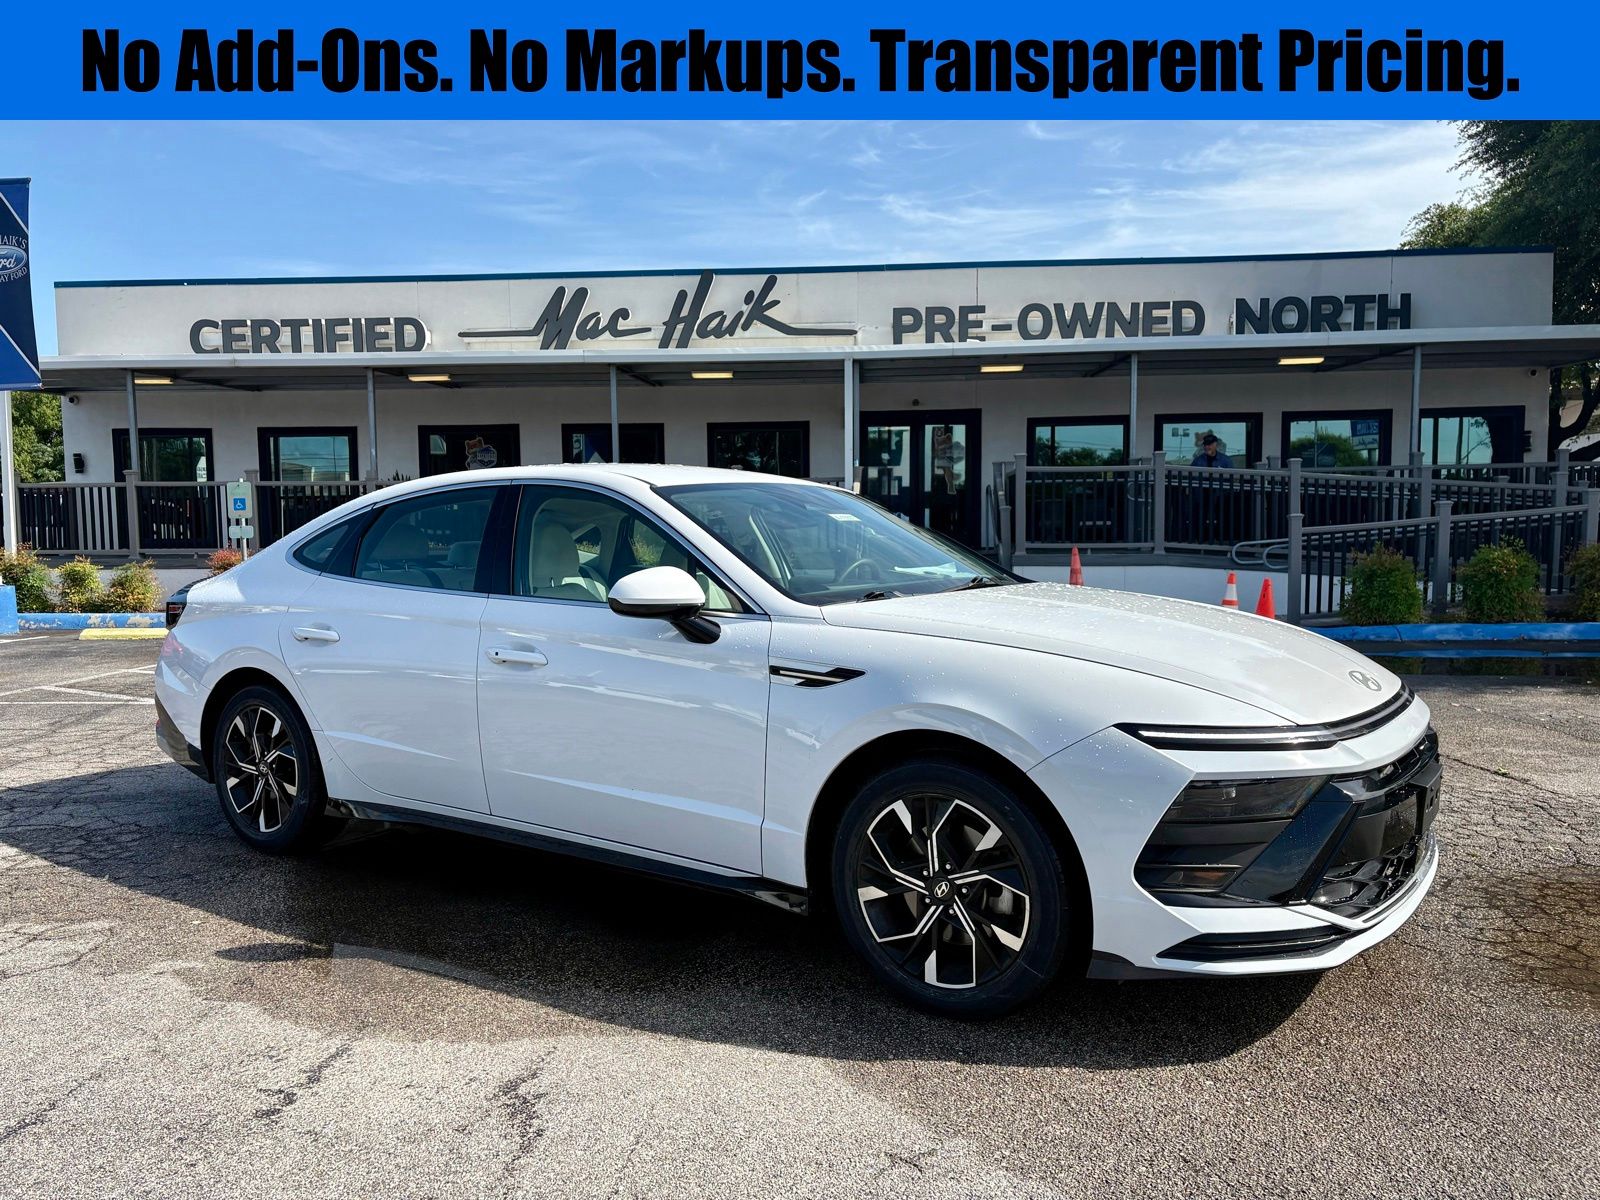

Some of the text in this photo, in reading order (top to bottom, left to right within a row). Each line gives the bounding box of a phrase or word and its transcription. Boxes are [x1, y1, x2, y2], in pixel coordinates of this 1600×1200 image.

[10, 266, 28, 281] FORD
[458, 270, 858, 350] Mac Haik
[892, 293, 1411, 345] PRE-OWNED NORTH
[189, 318, 427, 354] CERTIFIED
